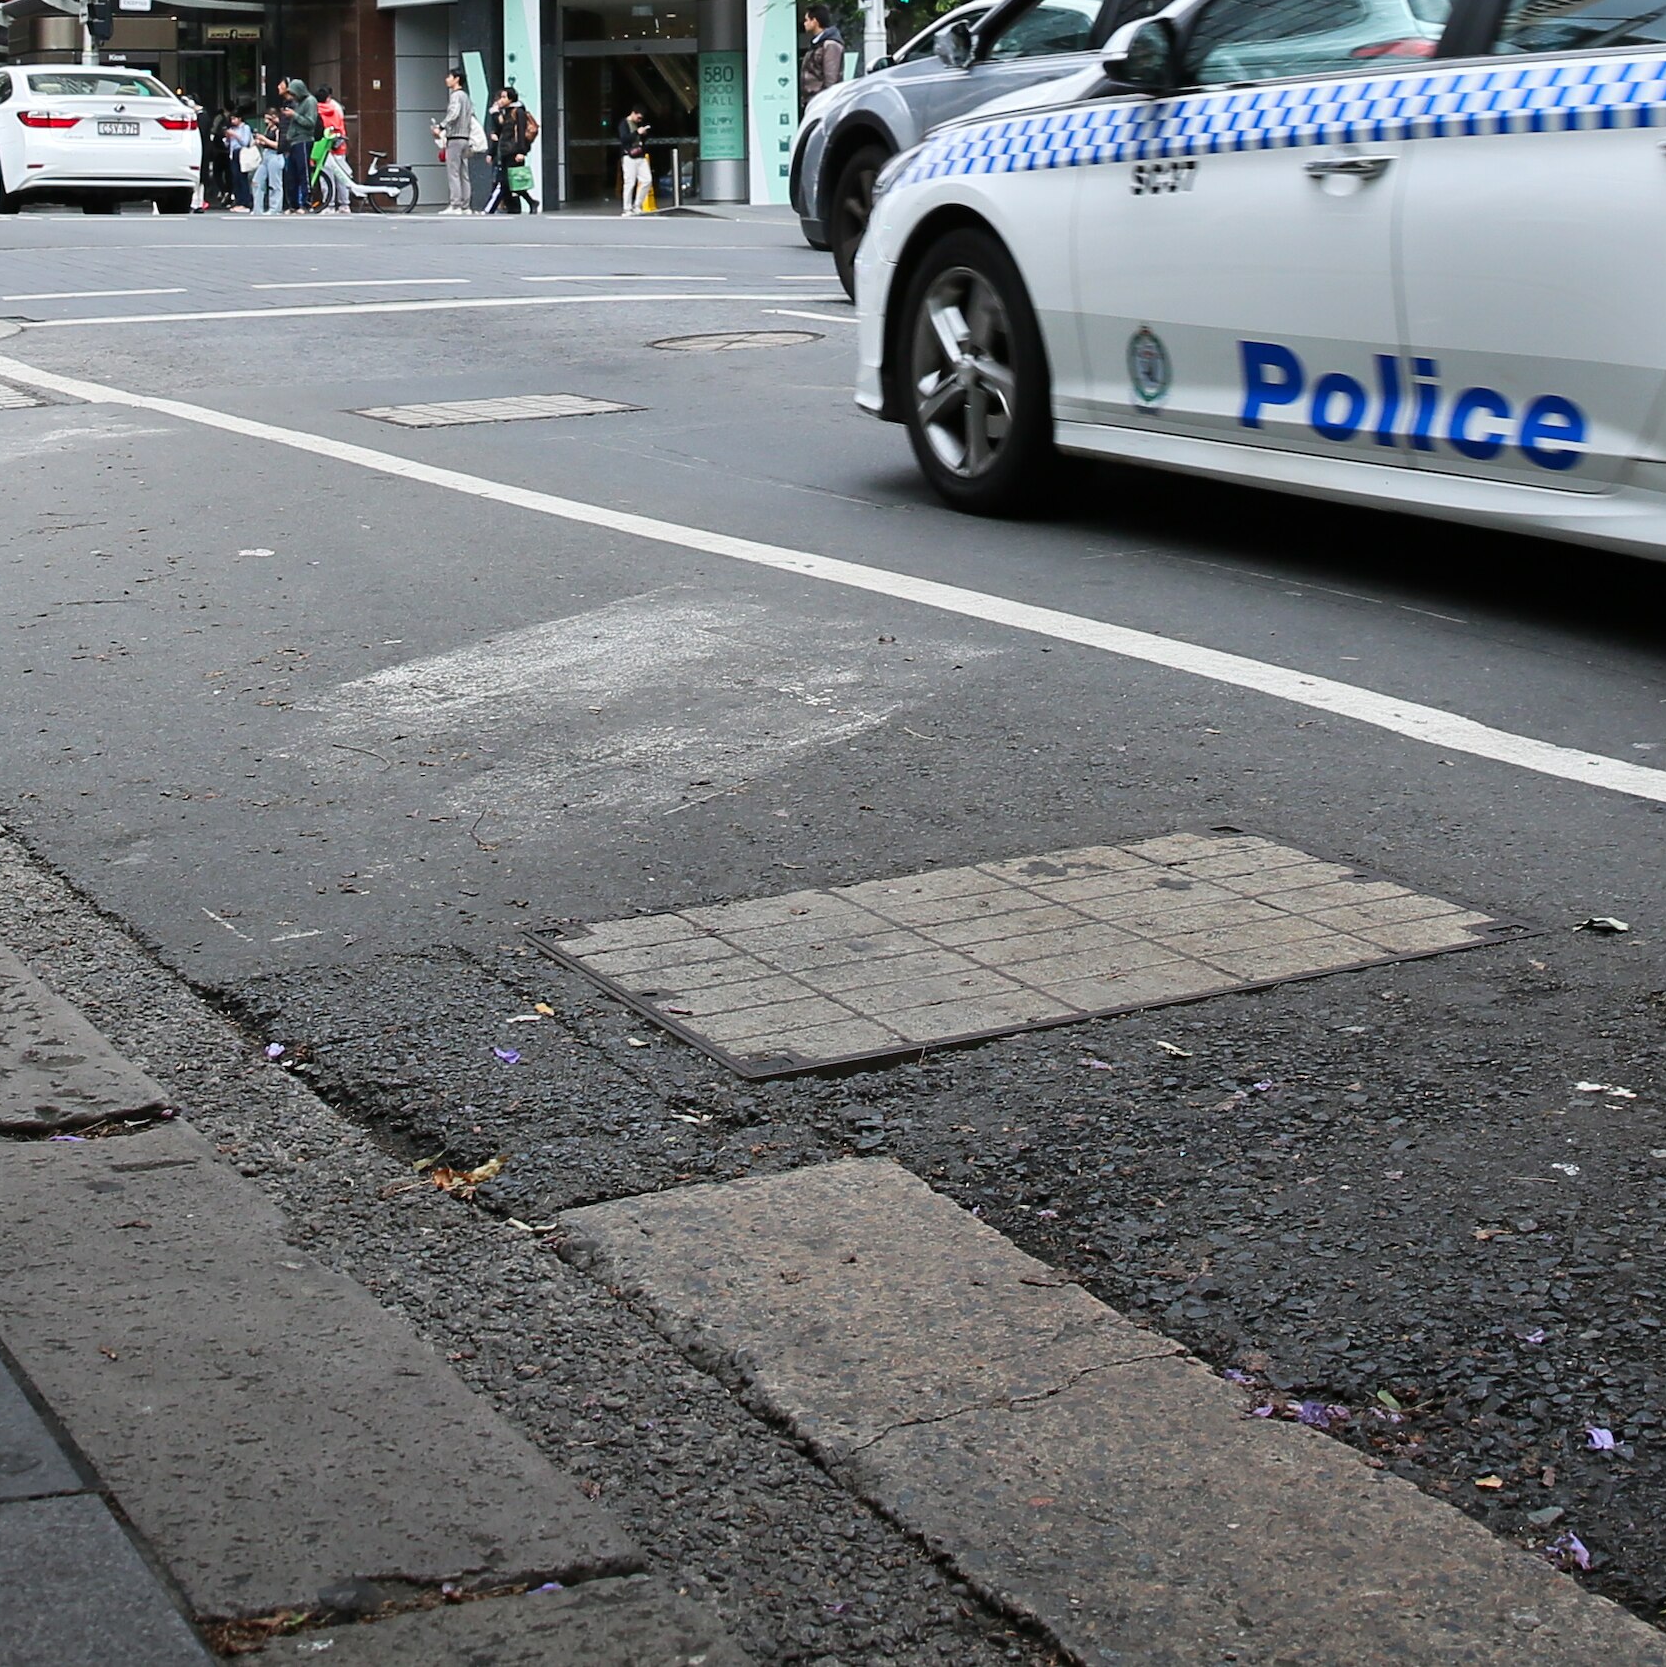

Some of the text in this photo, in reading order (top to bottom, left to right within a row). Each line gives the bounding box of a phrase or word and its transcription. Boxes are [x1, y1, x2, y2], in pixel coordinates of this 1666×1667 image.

[109, 54, 126, 62] Kiosk
[704, 66, 734, 83] 580
[704, 84, 734, 94] FOOD
[704, 96, 734, 106] HALL
[1237, 340, 1590, 472] Police
